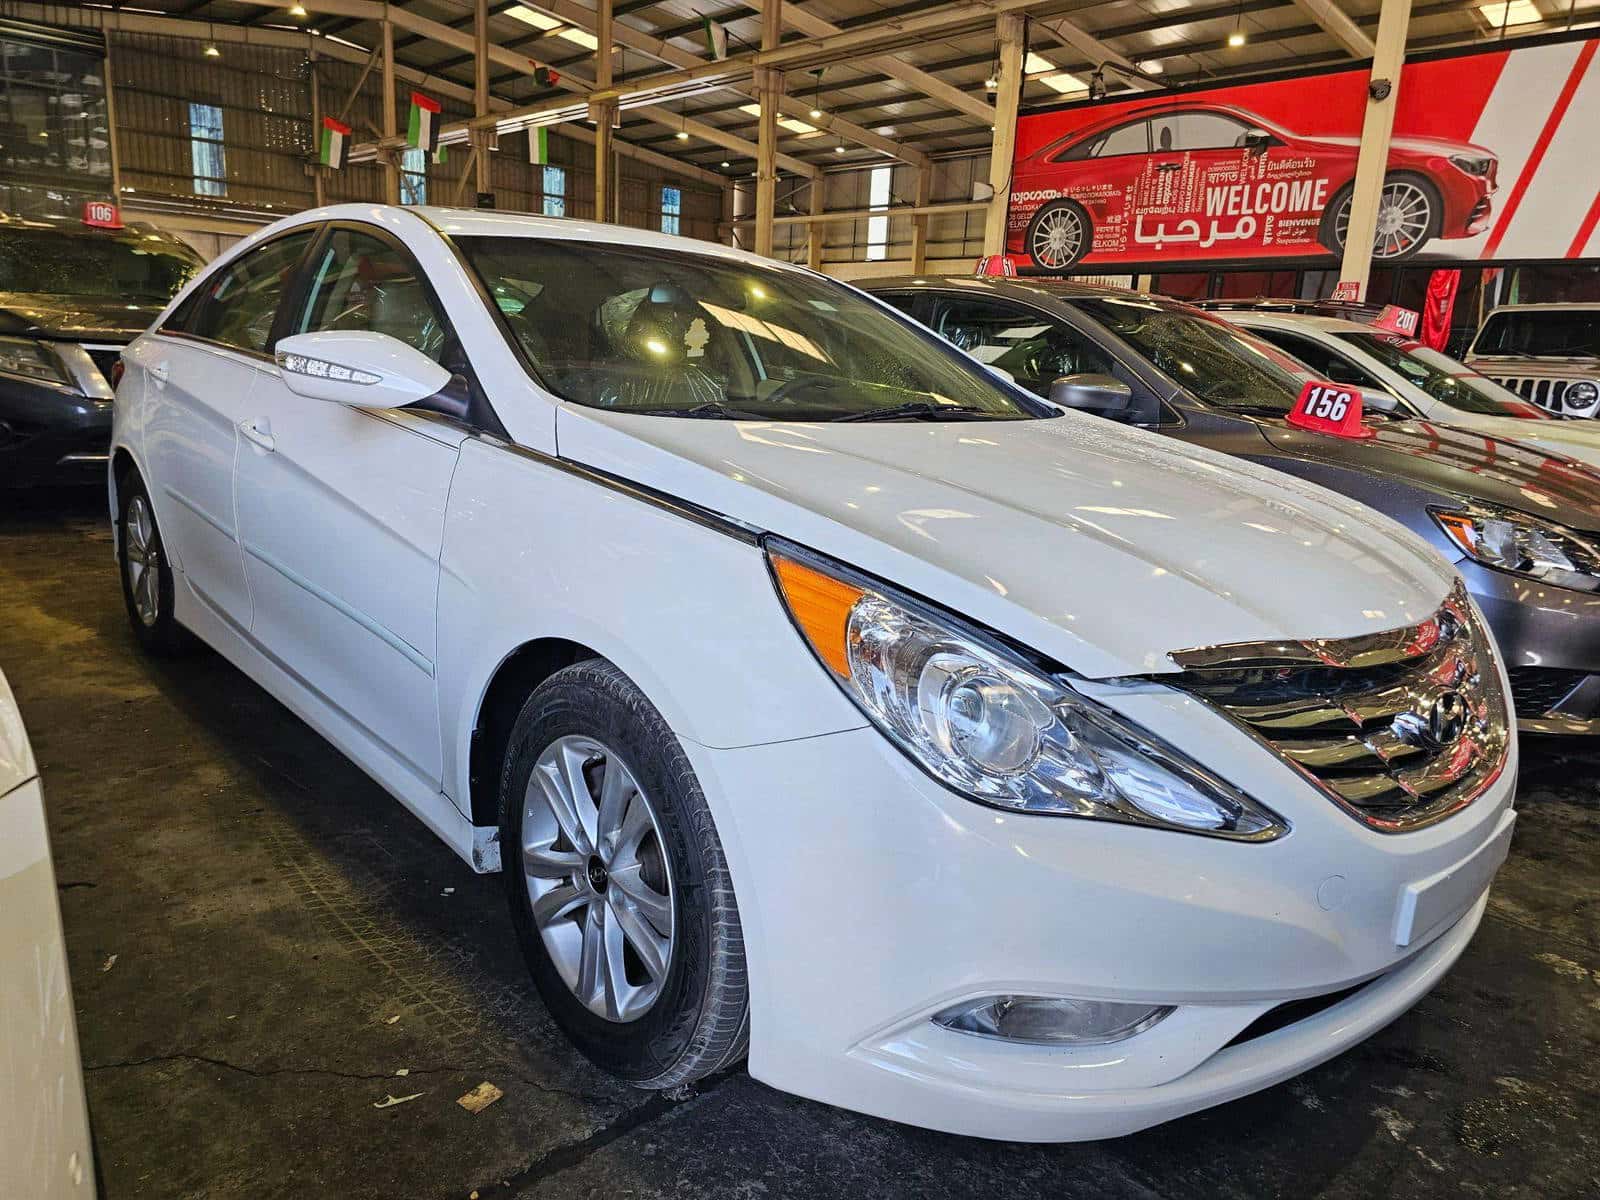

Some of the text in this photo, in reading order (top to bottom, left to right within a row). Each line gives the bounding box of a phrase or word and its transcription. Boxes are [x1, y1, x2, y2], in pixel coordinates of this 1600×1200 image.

[1206, 179, 1329, 217] WELCOME
[92, 206, 112, 221] 106
[1278, 218, 1321, 228] BIENVENUE
[1134, 215, 1256, 250] مرحبا
[1003, 258, 1012, 277] 61
[1396, 311, 1416, 331] 201
[1304, 387, 1351, 421] 156
